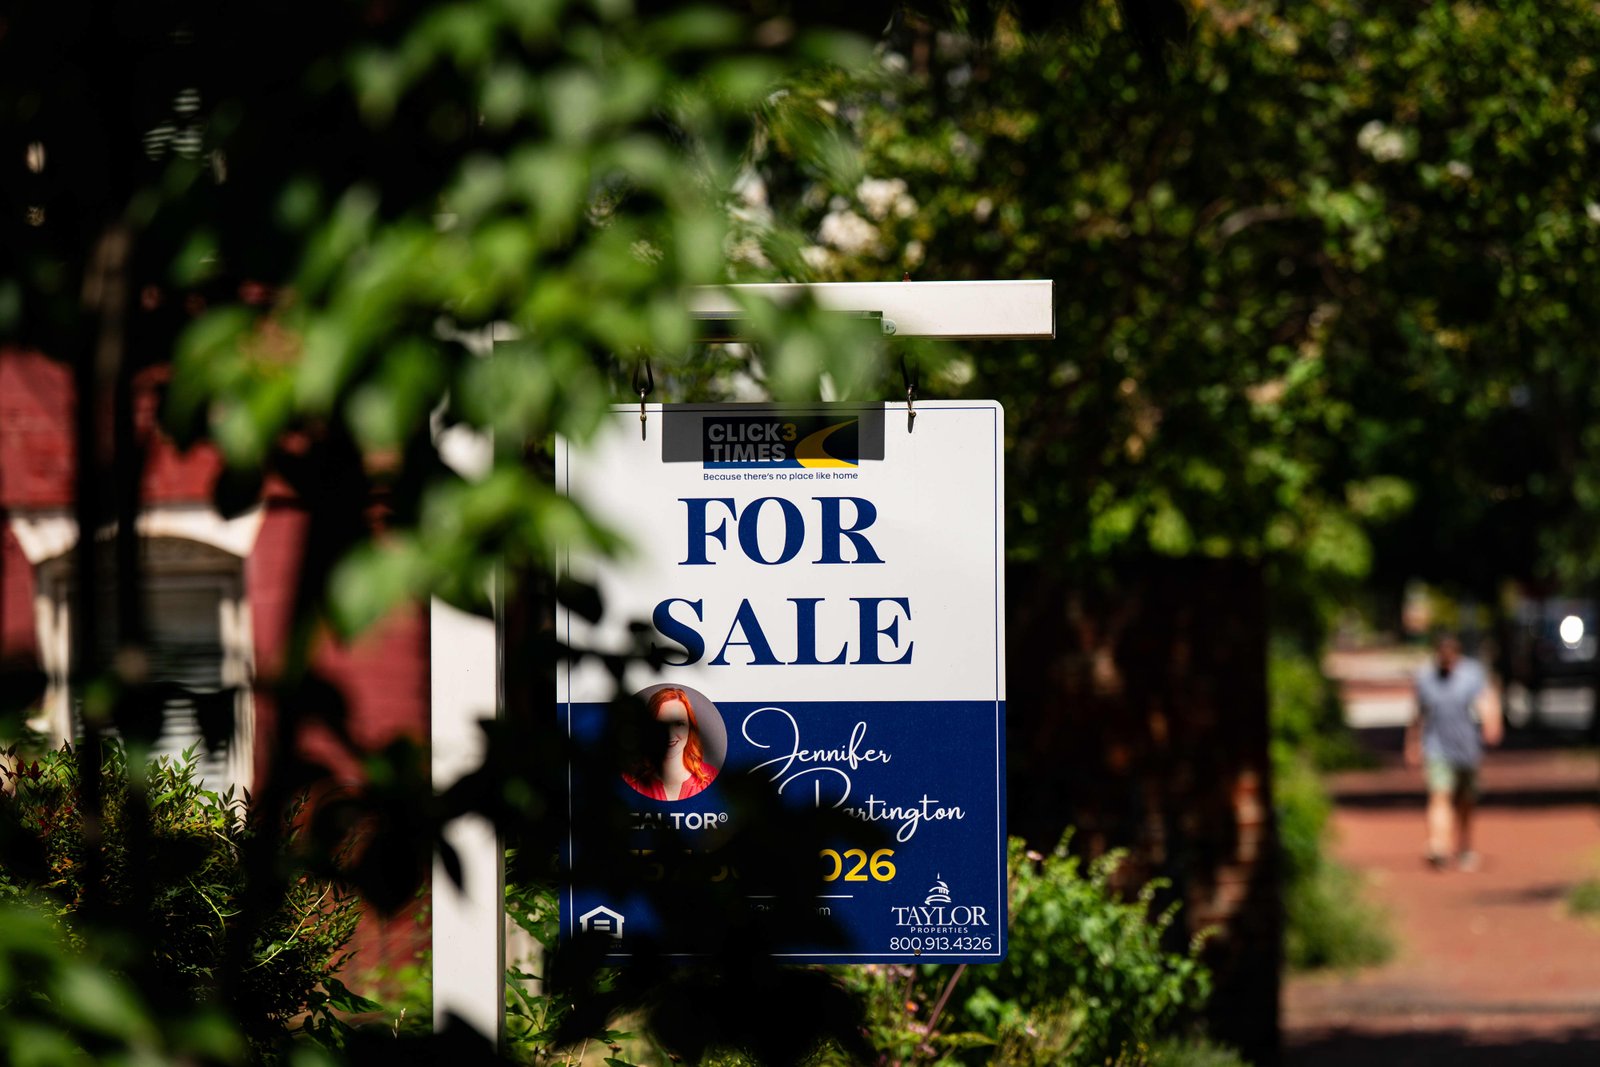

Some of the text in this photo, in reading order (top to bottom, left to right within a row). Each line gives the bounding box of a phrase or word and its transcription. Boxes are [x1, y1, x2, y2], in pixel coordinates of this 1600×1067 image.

[710, 443, 786, 463] TIMES
[703, 473, 742, 481] Because
[744, 472, 774, 481] there's
[789, 472, 814, 482] place
[816, 472, 831, 480] like
[833, 472, 858, 480] home
[677, 496, 886, 565] FOR
[652, 597, 914, 667] SALE
[741, 707, 892, 783] Jennifer
[891, 905, 990, 926] TAYLOR
[910, 926, 969, 934] PROPERTIES
[890, 936, 992, 951] 800.913.4326
